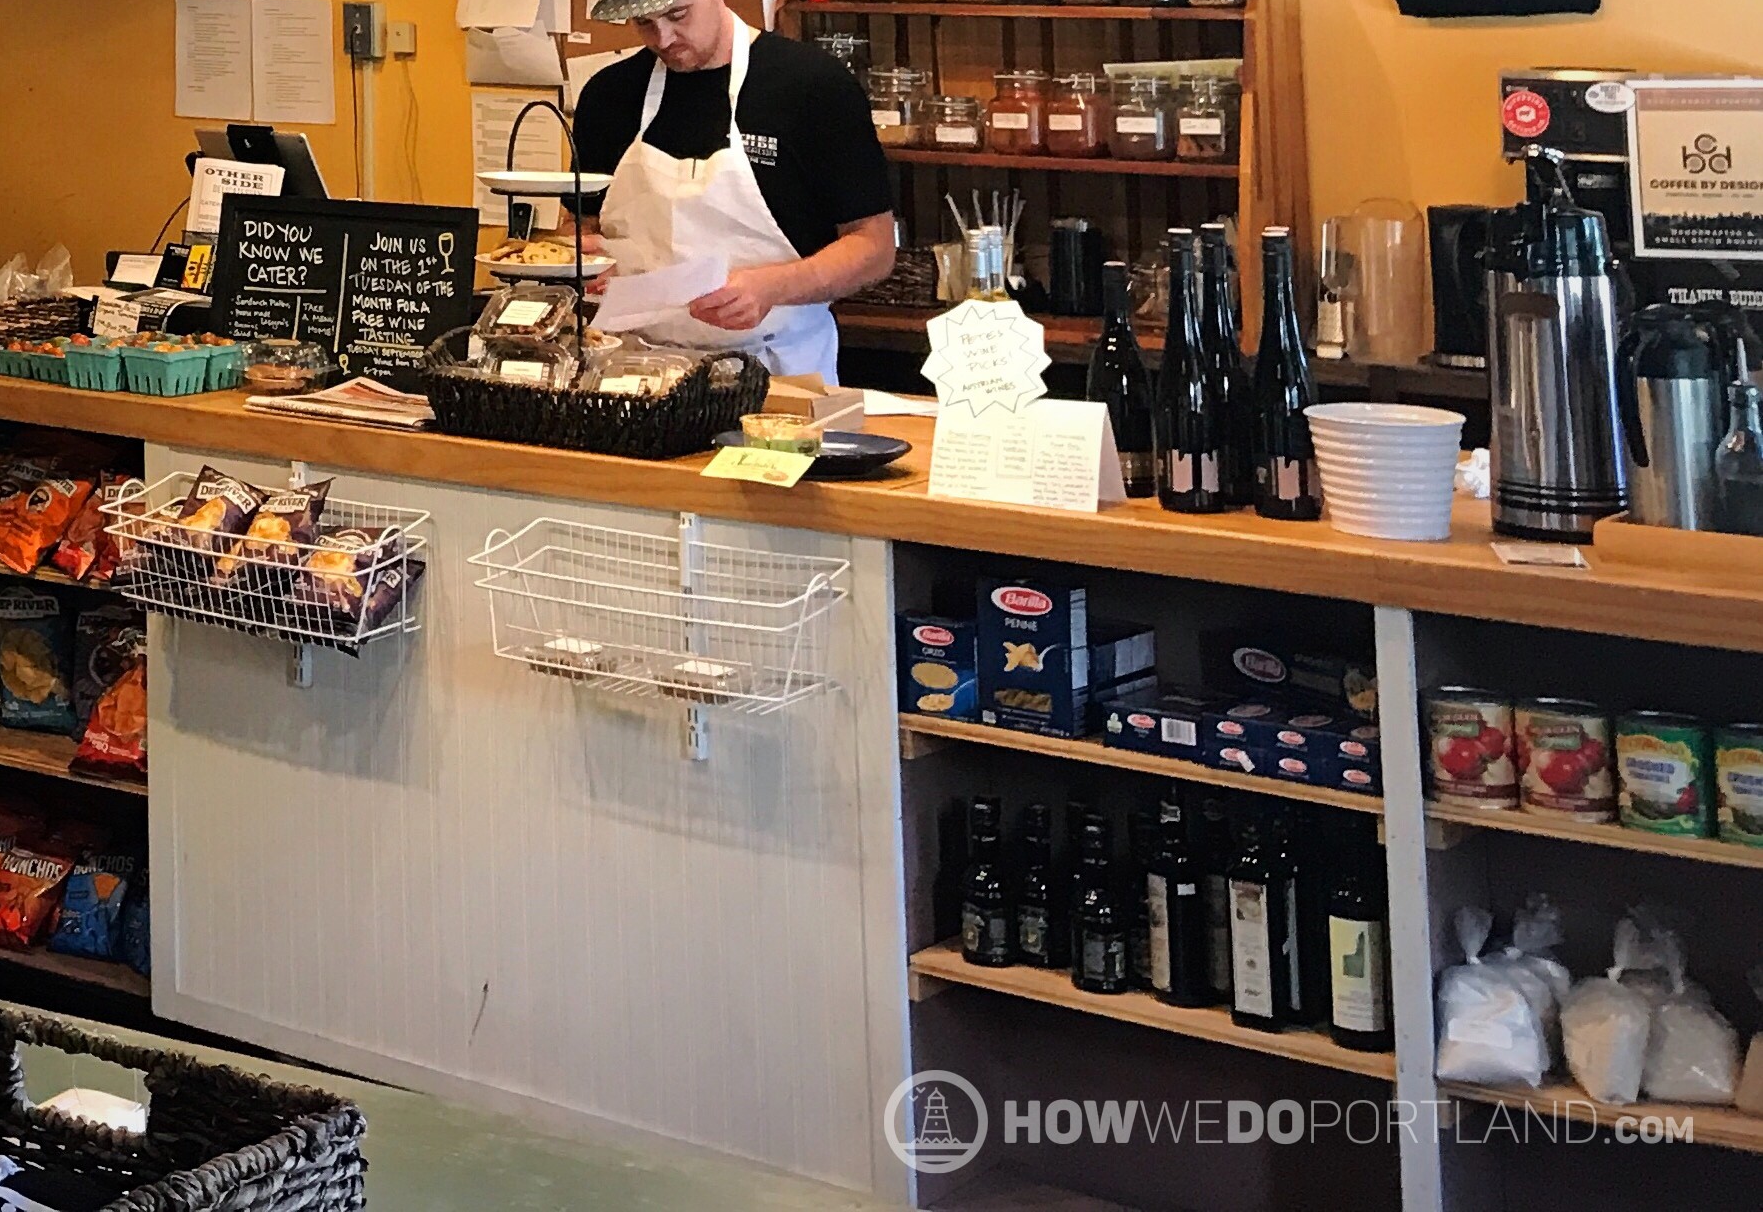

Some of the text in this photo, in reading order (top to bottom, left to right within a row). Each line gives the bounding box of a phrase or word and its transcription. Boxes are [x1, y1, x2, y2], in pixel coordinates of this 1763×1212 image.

[205, 167, 264, 182] OTHER
[221, 177, 264, 190] SIDE
[1649, 179, 1698, 189] COFFEE
[1700, 179, 1717, 189] BY
[244, 220, 313, 243] DID YOU
[239, 241, 324, 264] KNOW WE
[370, 232, 426, 255] JOIN US
[247, 263, 308, 286] CATER?
[360, 257, 378, 271] ON
[381, 258, 412, 275] THE
[348, 271, 455, 297] TUESDAY OF THE
[303, 302, 324, 313] TAKE
[352, 294, 430, 314] MONTH FOR A
[351, 310, 426, 331] FREE WINE
[358, 328, 415, 345] TASTING
[346, 344, 380, 356] TUESDAY
[13, 598, 57, 612] RIVER
[1004, 590, 1048, 609] Barilla
[1004, 616, 1039, 633] PENNE
[1, 854, 64, 881] HONCHOS
